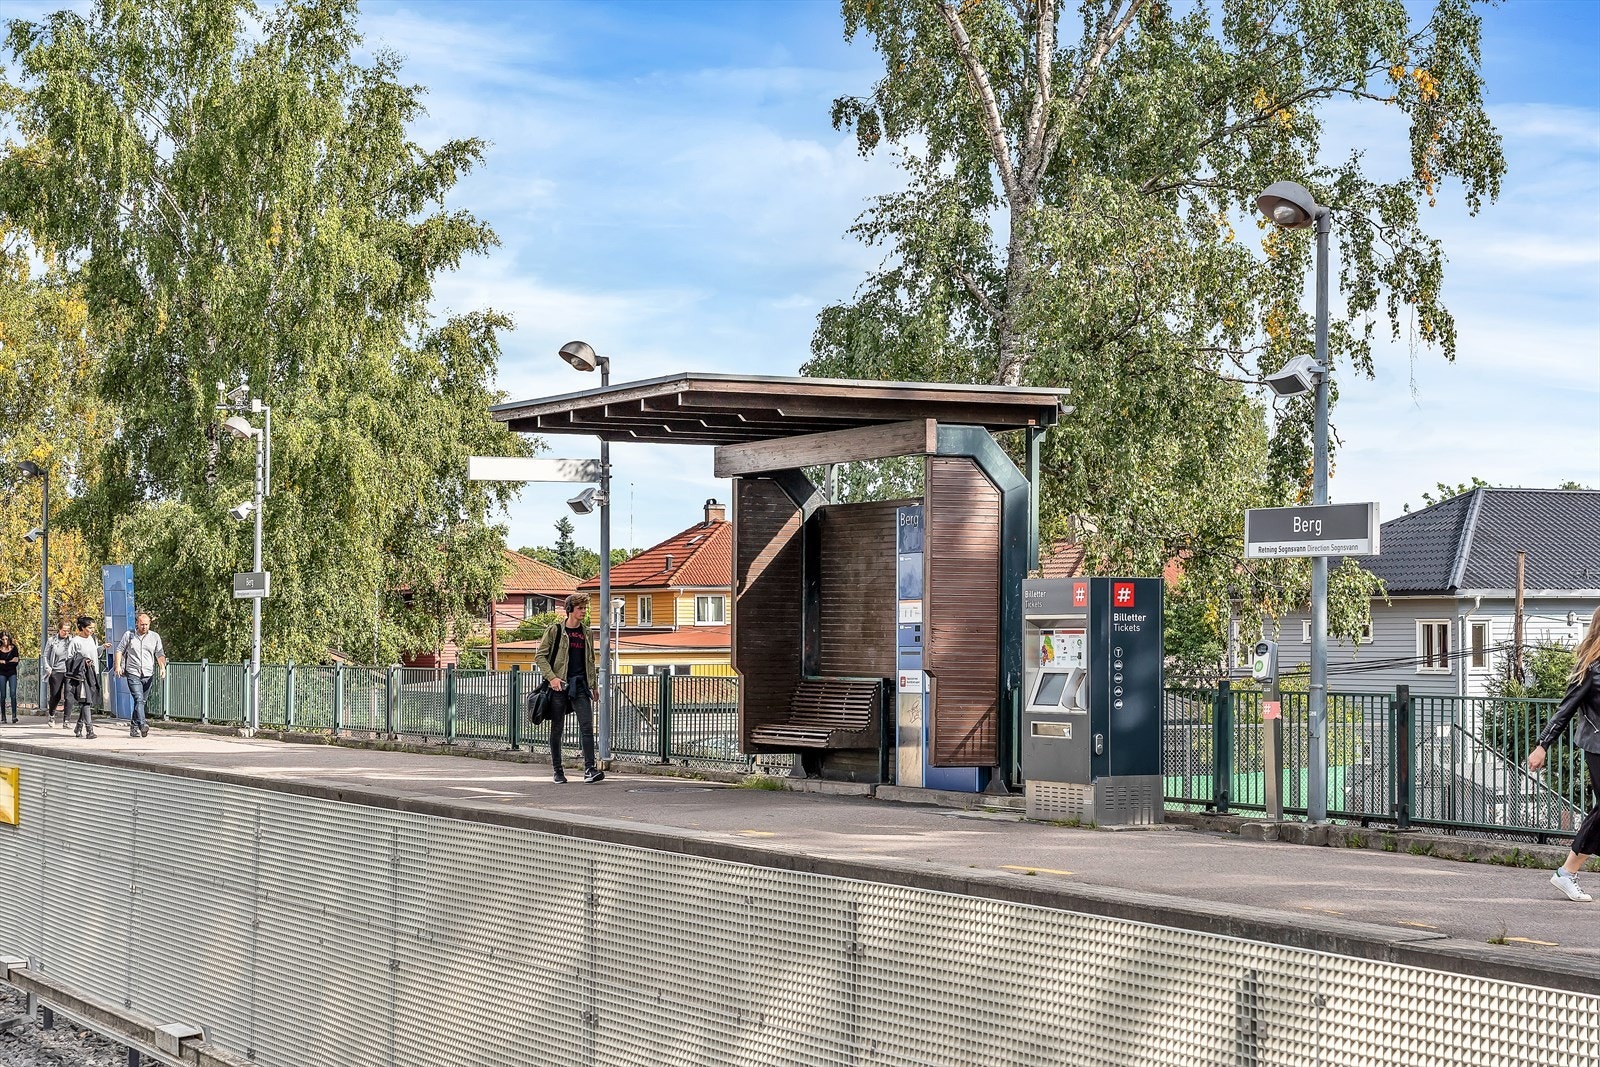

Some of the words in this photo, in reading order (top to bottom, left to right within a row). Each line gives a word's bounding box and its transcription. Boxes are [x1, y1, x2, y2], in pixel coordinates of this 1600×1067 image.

[900, 512, 919, 528] Berg
[1293, 516, 1322, 536] Berg
[1258, 545, 1277, 554] Retning
[1278, 545, 1306, 554] Sognsvann
[1331, 544, 1359, 553] Sognsvann
[1024, 590, 1046, 599] Billetter
[1025, 600, 1043, 608] Tickets
[1113, 613, 1147, 622] Billetter
[1113, 623, 1141, 632] Tickets
